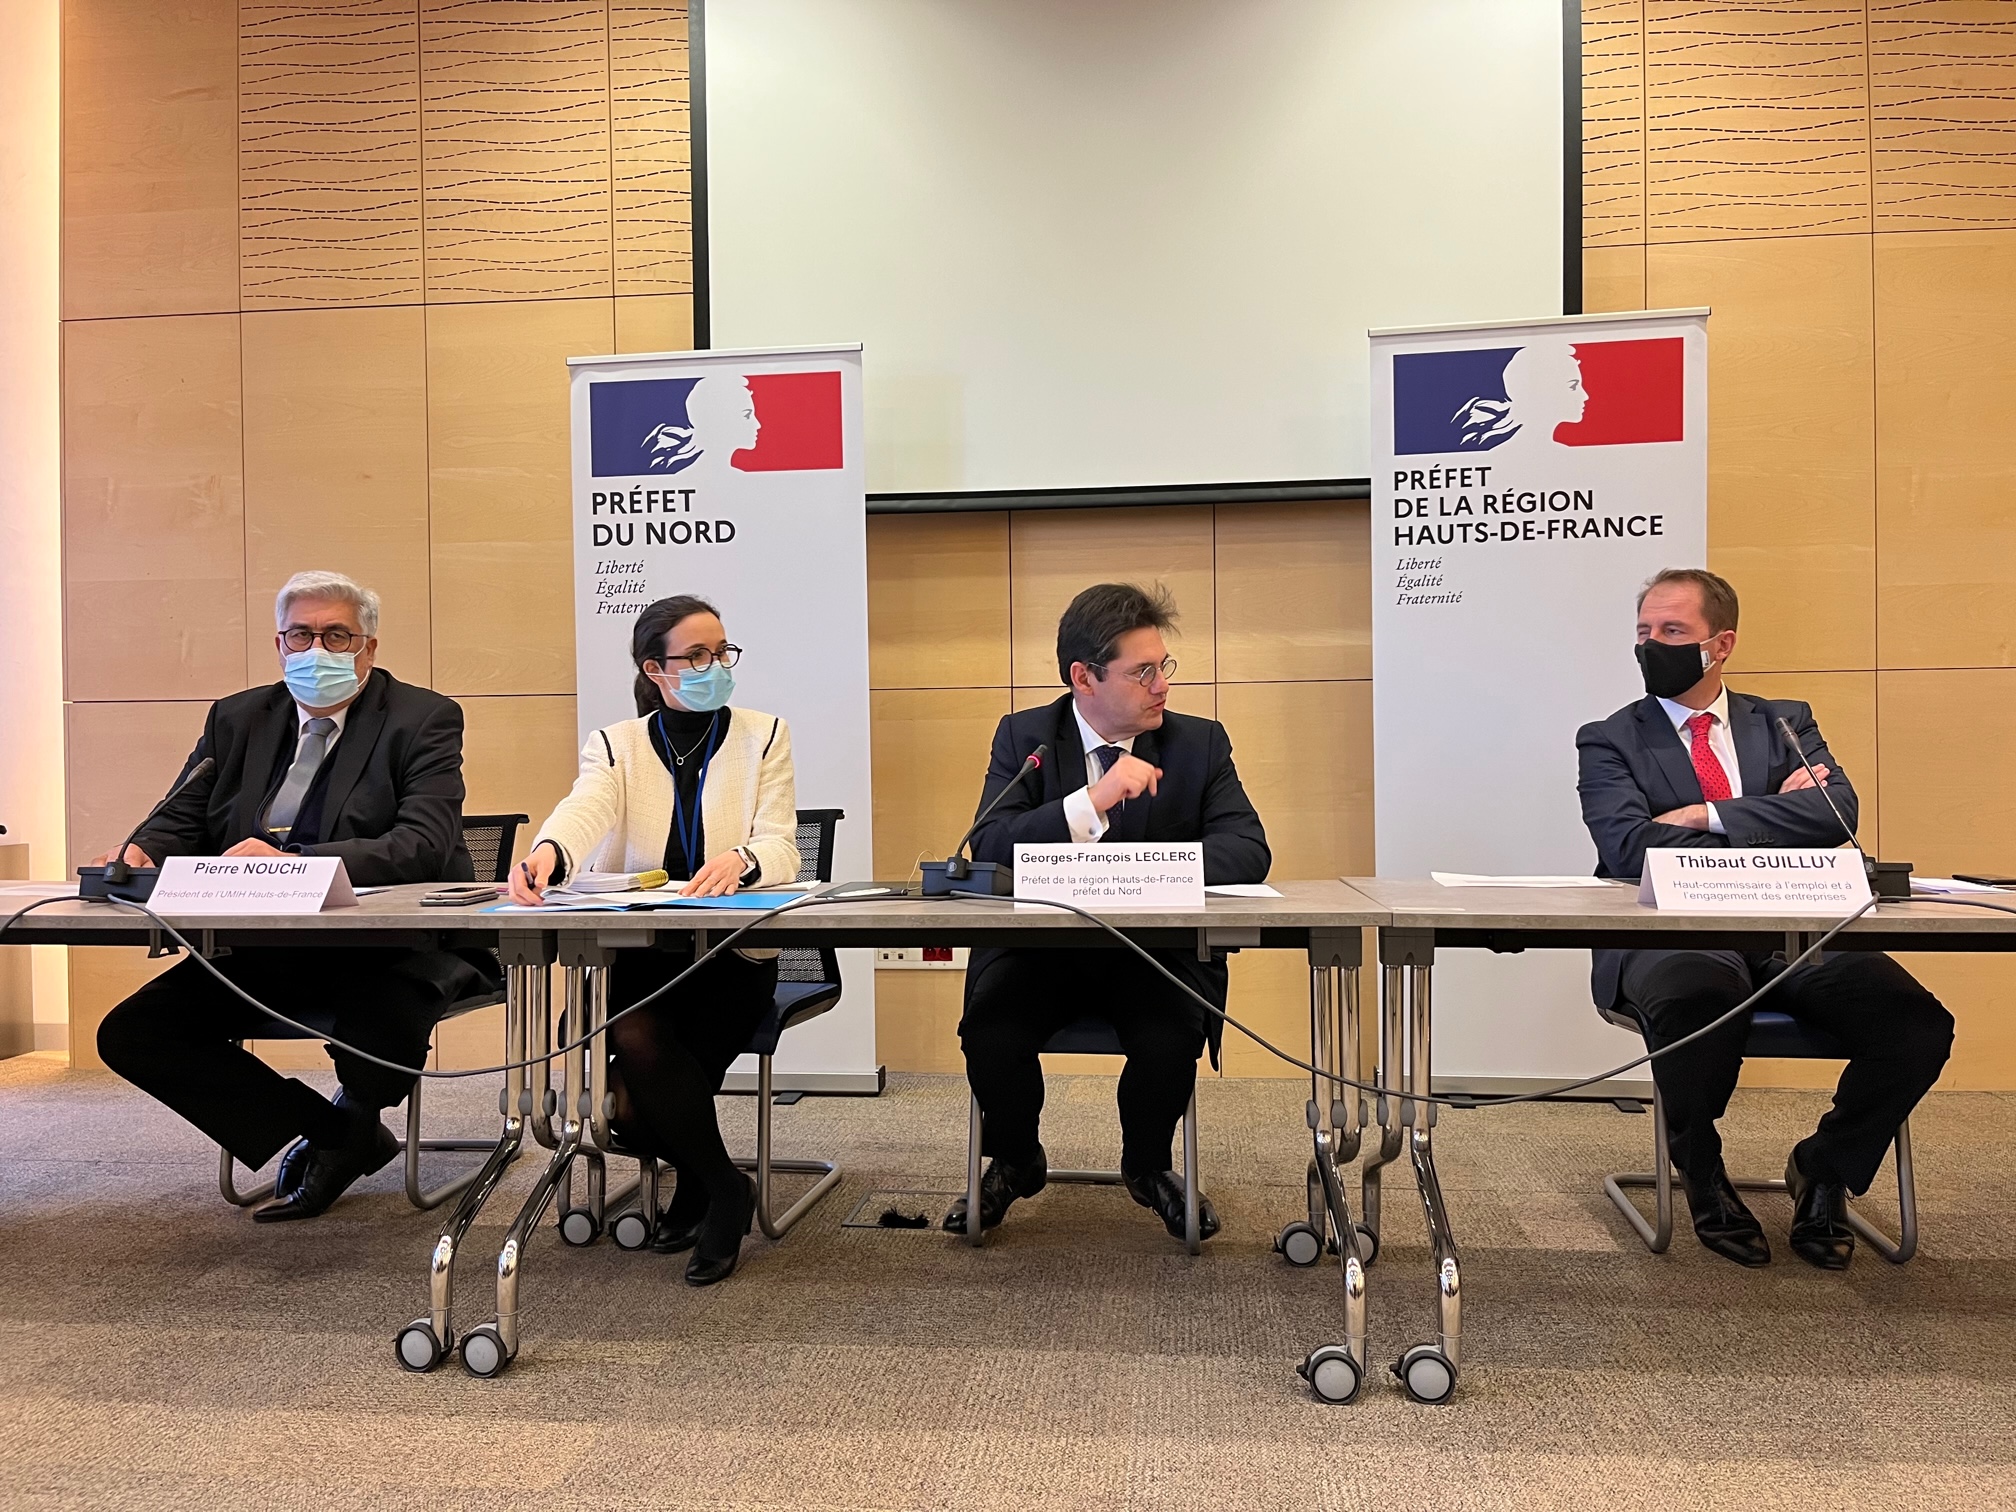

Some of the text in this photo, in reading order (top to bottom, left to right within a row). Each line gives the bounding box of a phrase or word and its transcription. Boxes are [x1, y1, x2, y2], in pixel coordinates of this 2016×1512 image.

[1393, 463, 1492, 491] PRÉFET
[591, 484, 696, 515] PRÉFET
[1394, 488, 1593, 519] DE LA RÉGION
[592, 520, 736, 547] DU NORD
[1394, 515, 1664, 546] HAUTS-DE-FRANCE
[594, 559, 645, 575] Liberté
[1395, 556, 1443, 571] Liberté
[594, 578, 647, 598] Égalité
[1395, 573, 1444, 591] Égalité
[1395, 590, 1463, 606] Fraternité
[1020, 851, 1197, 866] Georges-François LECLERC
[1675, 854, 1838, 869] Thibaut GUILLUY
[193, 862, 308, 875] Pierre NOUCHI
[1021, 874, 1194, 887] Préfet de la région Hauts-de-France
[1672, 879, 1772, 891] Haut-commissaire
[1775, 880, 1783, 891] à
[1830, 881, 1843, 891] et
[1844, 880, 1852, 891] à
[156, 889, 200, 899] Président
[202, 889, 214, 899] de
[248, 889, 324, 899] Hauts-de-France
[1072, 886, 1142, 898] préfet du Nord
[1761, 891, 1782, 901] des
[1784, 890, 1848, 903] entreprises
